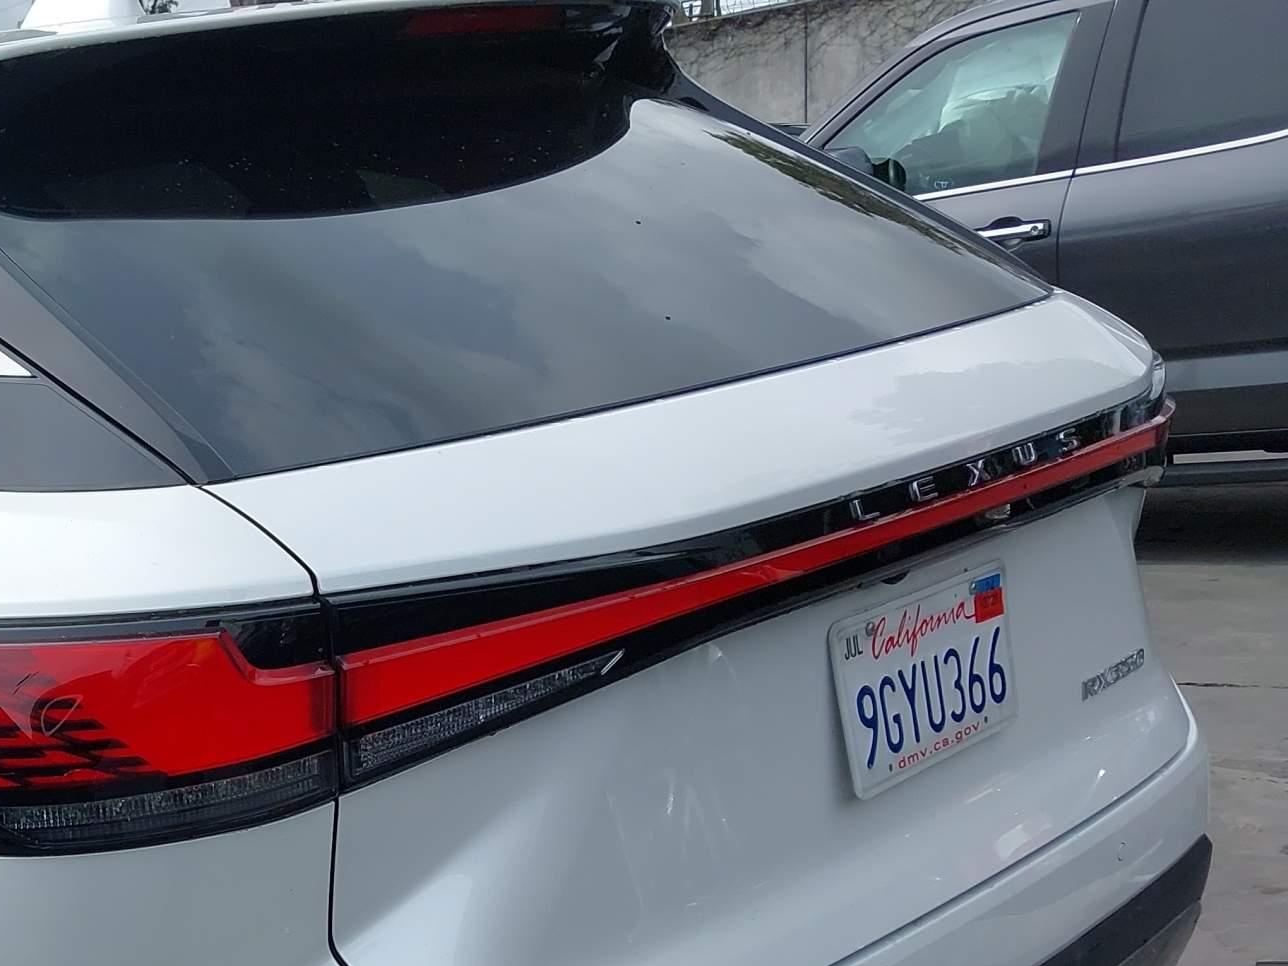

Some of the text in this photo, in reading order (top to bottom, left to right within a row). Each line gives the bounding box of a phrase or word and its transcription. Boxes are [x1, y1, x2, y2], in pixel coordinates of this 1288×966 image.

[849, 428, 1081, 522] LEXUS
[844, 634, 864, 661] JUL
[871, 595, 976, 661] California
[856, 626, 1007, 770] 9GYU366
[898, 720, 981, 770] dmv.ca.gov
